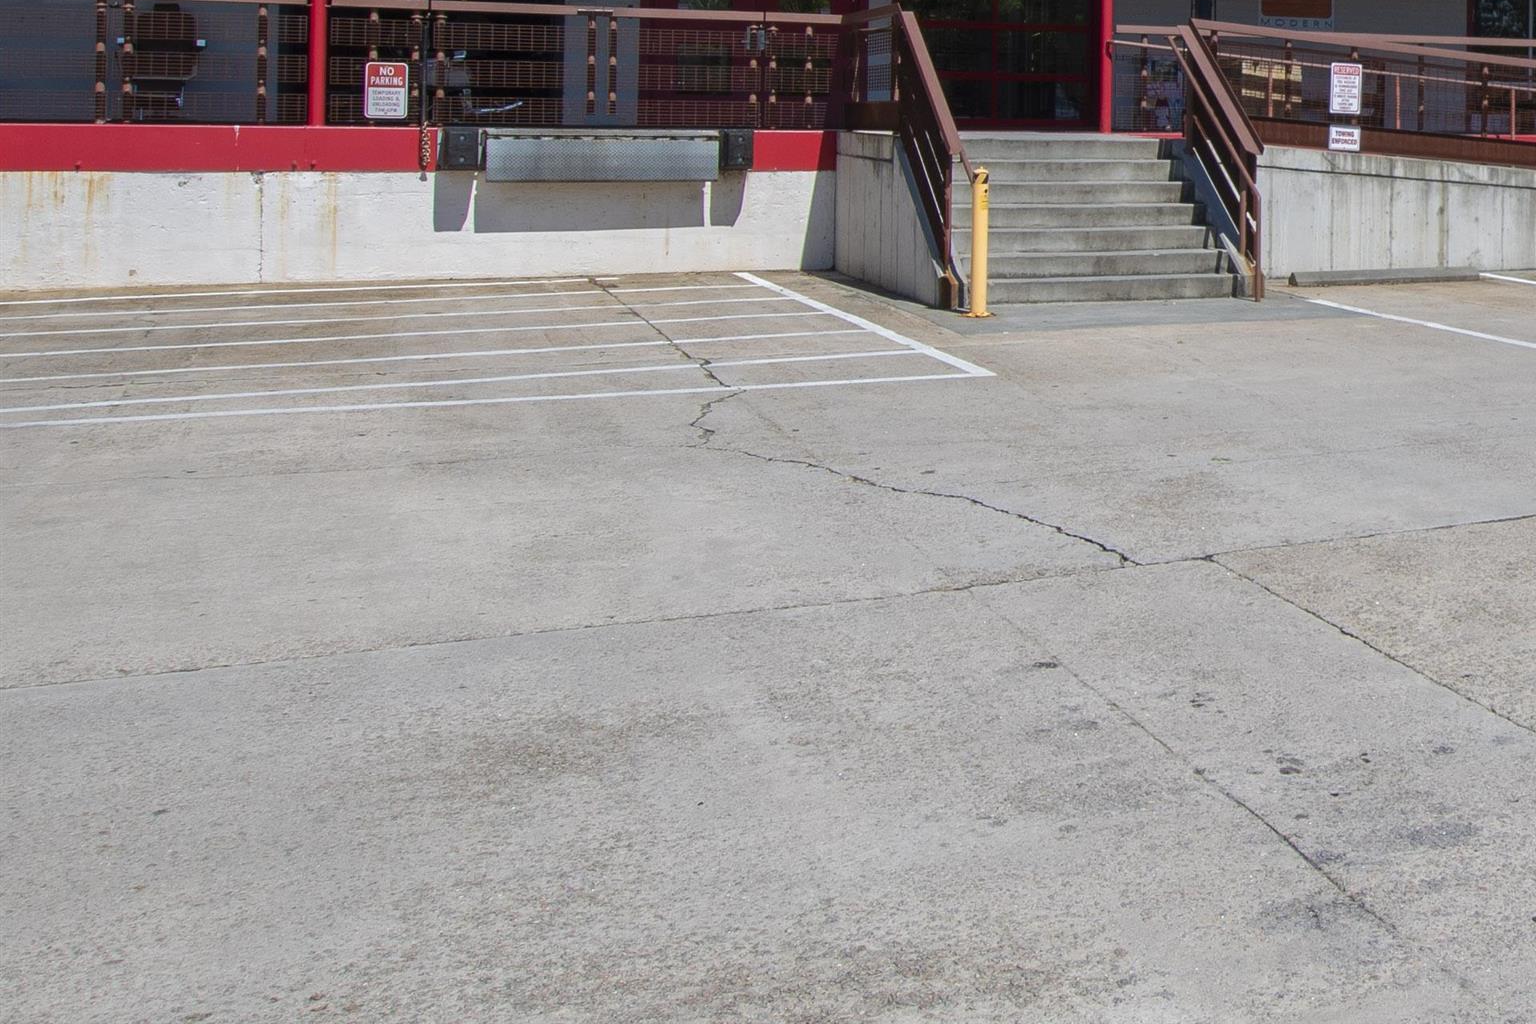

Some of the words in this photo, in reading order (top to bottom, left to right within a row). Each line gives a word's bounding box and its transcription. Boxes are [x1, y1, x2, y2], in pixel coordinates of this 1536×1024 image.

[1260, 18, 1333, 28] MODERN
[379, 66, 395, 76] NO
[370, 76, 404, 86] PARKING
[1335, 130, 1355, 138] TOWING
[1331, 137, 1358, 145] ENFORCED
